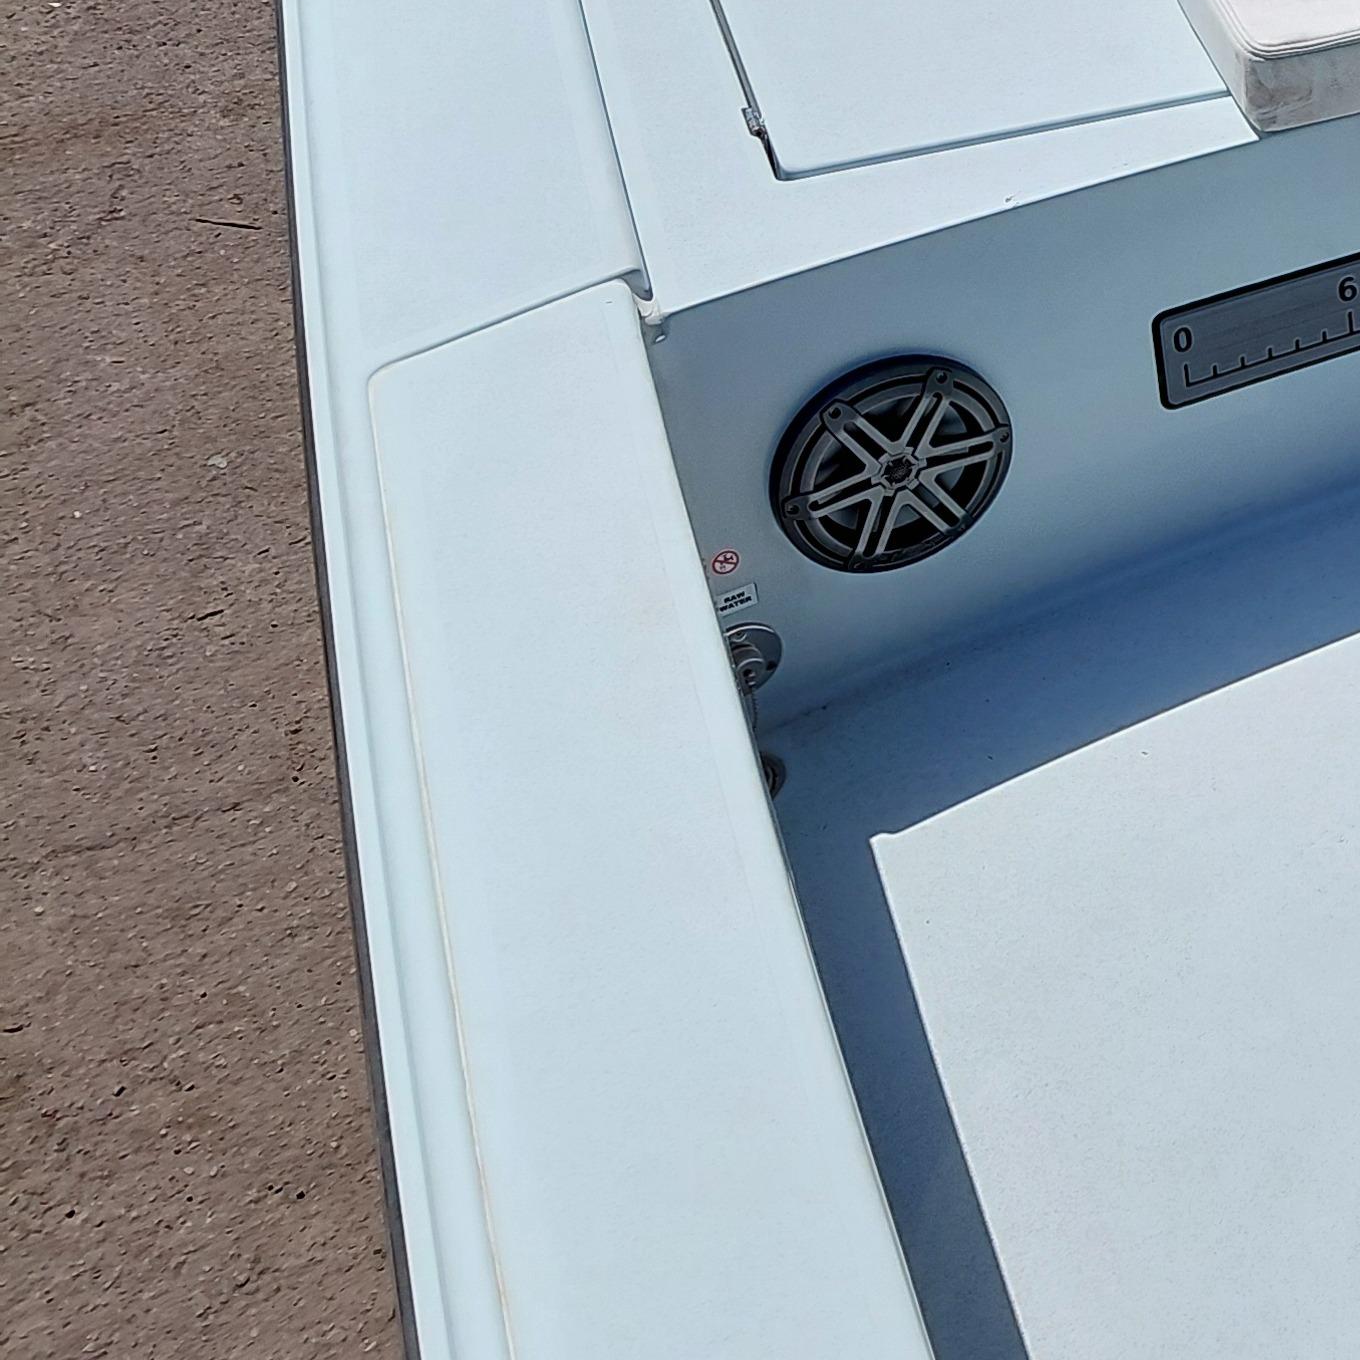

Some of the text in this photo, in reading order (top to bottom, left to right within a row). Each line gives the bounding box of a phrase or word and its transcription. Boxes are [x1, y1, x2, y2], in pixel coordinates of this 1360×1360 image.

[1173, 326, 1193, 352] 0
[1337, 276, 1358, 302] 6
[719, 596, 752, 612] WATER
